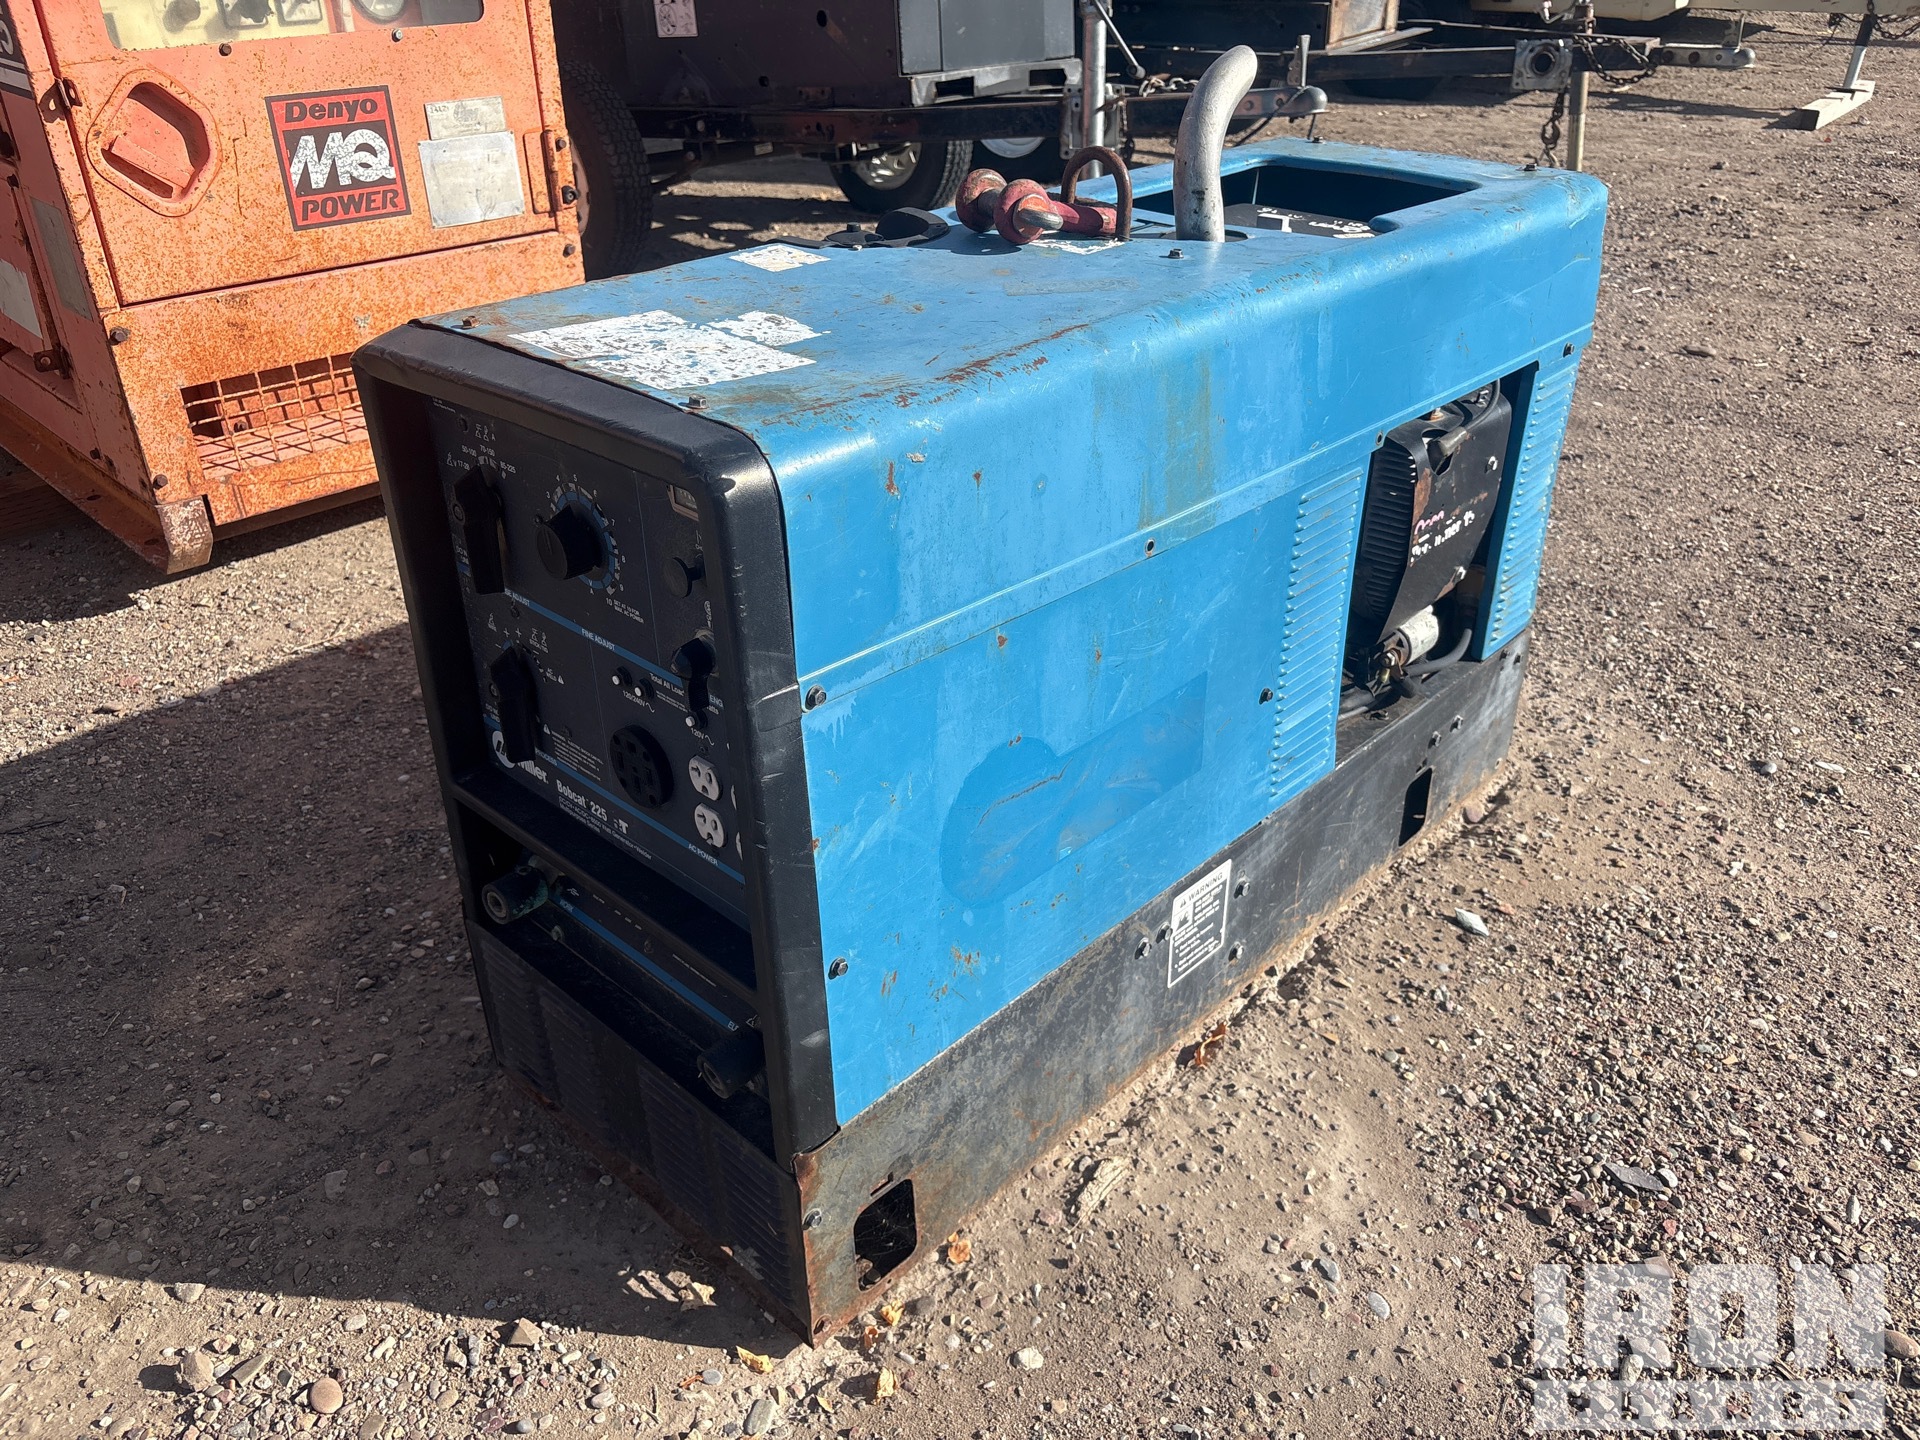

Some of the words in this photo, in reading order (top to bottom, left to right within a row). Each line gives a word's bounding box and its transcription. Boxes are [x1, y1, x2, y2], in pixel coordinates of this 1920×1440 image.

[285, 98, 378, 124] Denyo
[289, 128, 397, 191] MQ
[301, 188, 400, 222] POWER
[572, 473, 579, 482] 5
[544, 490, 552, 500] 3
[611, 518, 617, 527] 7
[621, 555, 628, 564] 8
[619, 583, 626, 592] 9
[605, 597, 613, 606] 10
[581, 627, 595, 642] FINE
[594, 635, 616, 651] ADJUST
[650, 672, 663, 686] Total
[622, 689, 646, 707] 120/240V
[690, 727, 705, 740] 120V
[556, 779, 588, 808] Bobcat
[589, 801, 609, 822] 225
[697, 848, 719, 866] POWER
[1188, 871, 1223, 902] WARNING
